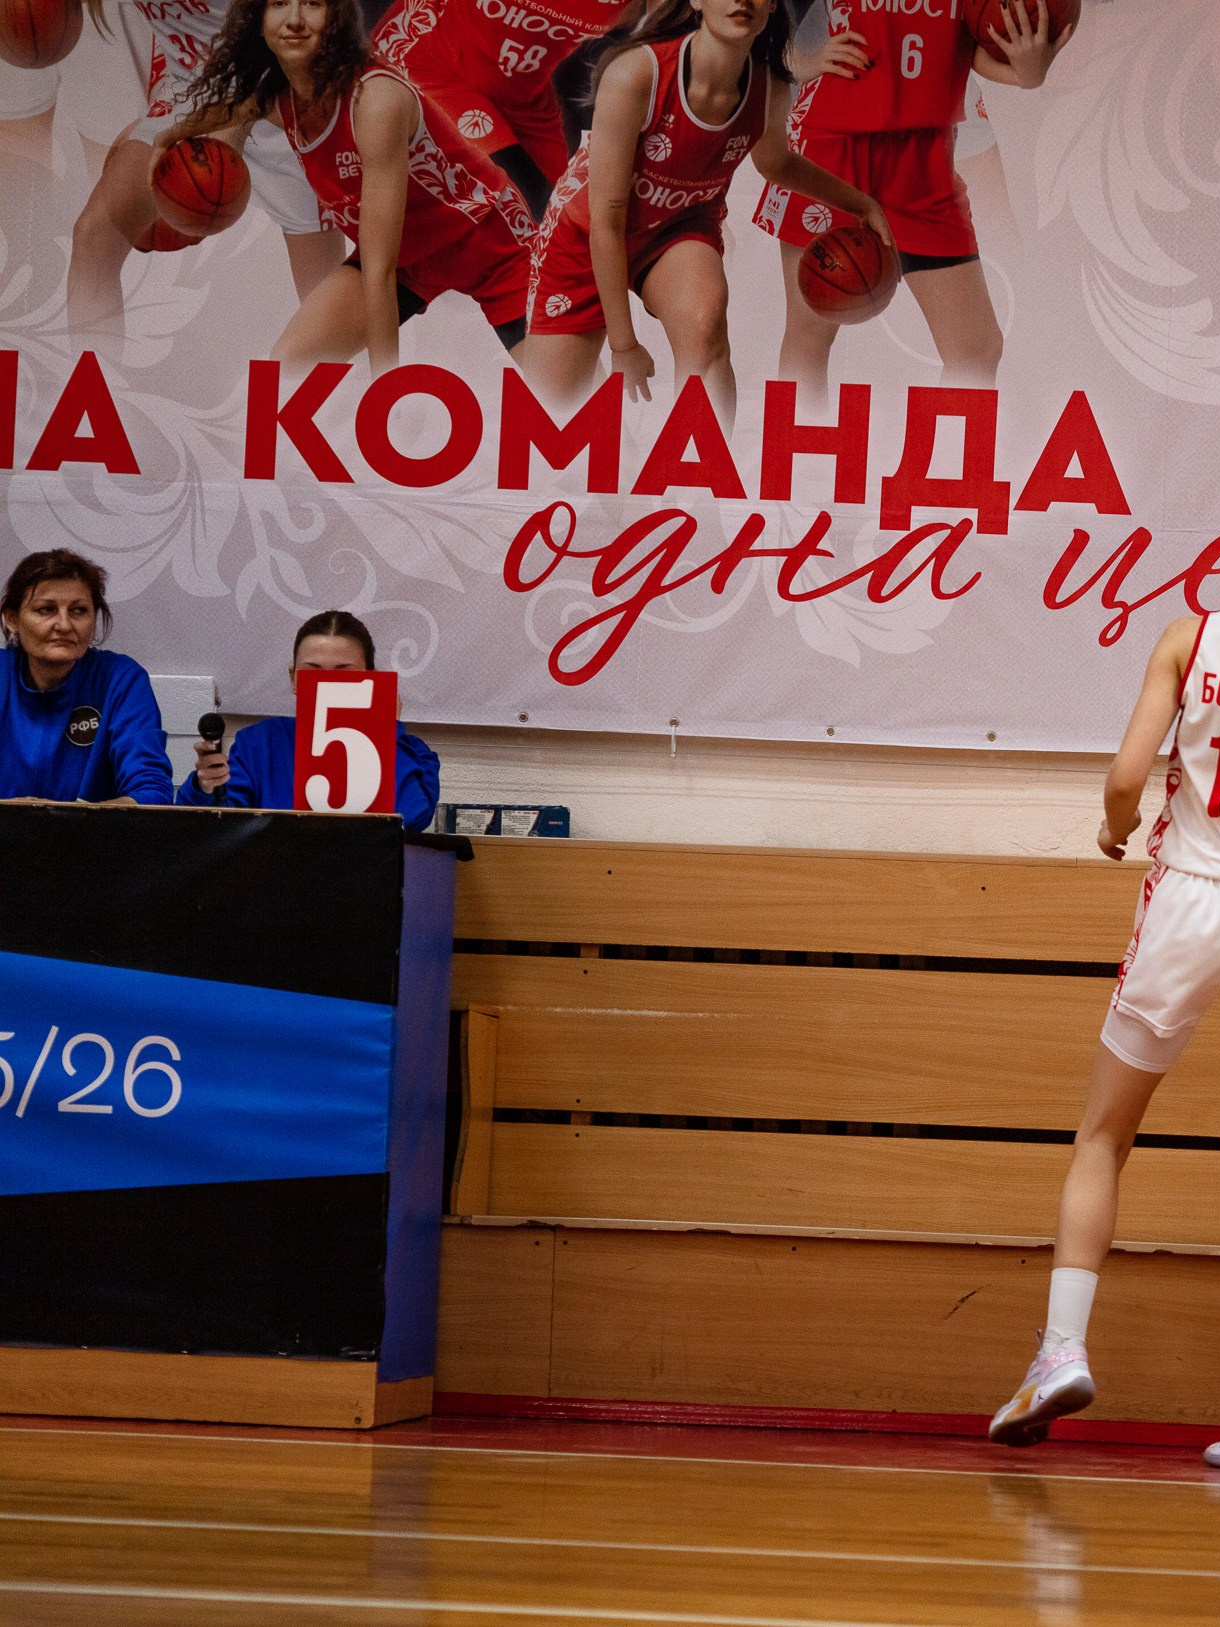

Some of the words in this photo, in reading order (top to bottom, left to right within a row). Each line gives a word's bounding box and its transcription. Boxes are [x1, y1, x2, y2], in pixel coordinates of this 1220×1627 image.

[476, 0, 606, 45] ЮНОСТ
[498, 38, 548, 77] 58
[900, 33, 924, 79] 6
[722, 148, 746, 162] BET
[725, 135, 751, 149] FON
[244, 359, 1131, 535] КОМАНДА
[503, 501, 982, 686] одна
[70, 717, 99, 734] РФБ
[305, 679, 382, 813] 5
[0, 1025, 182, 1117] /26
